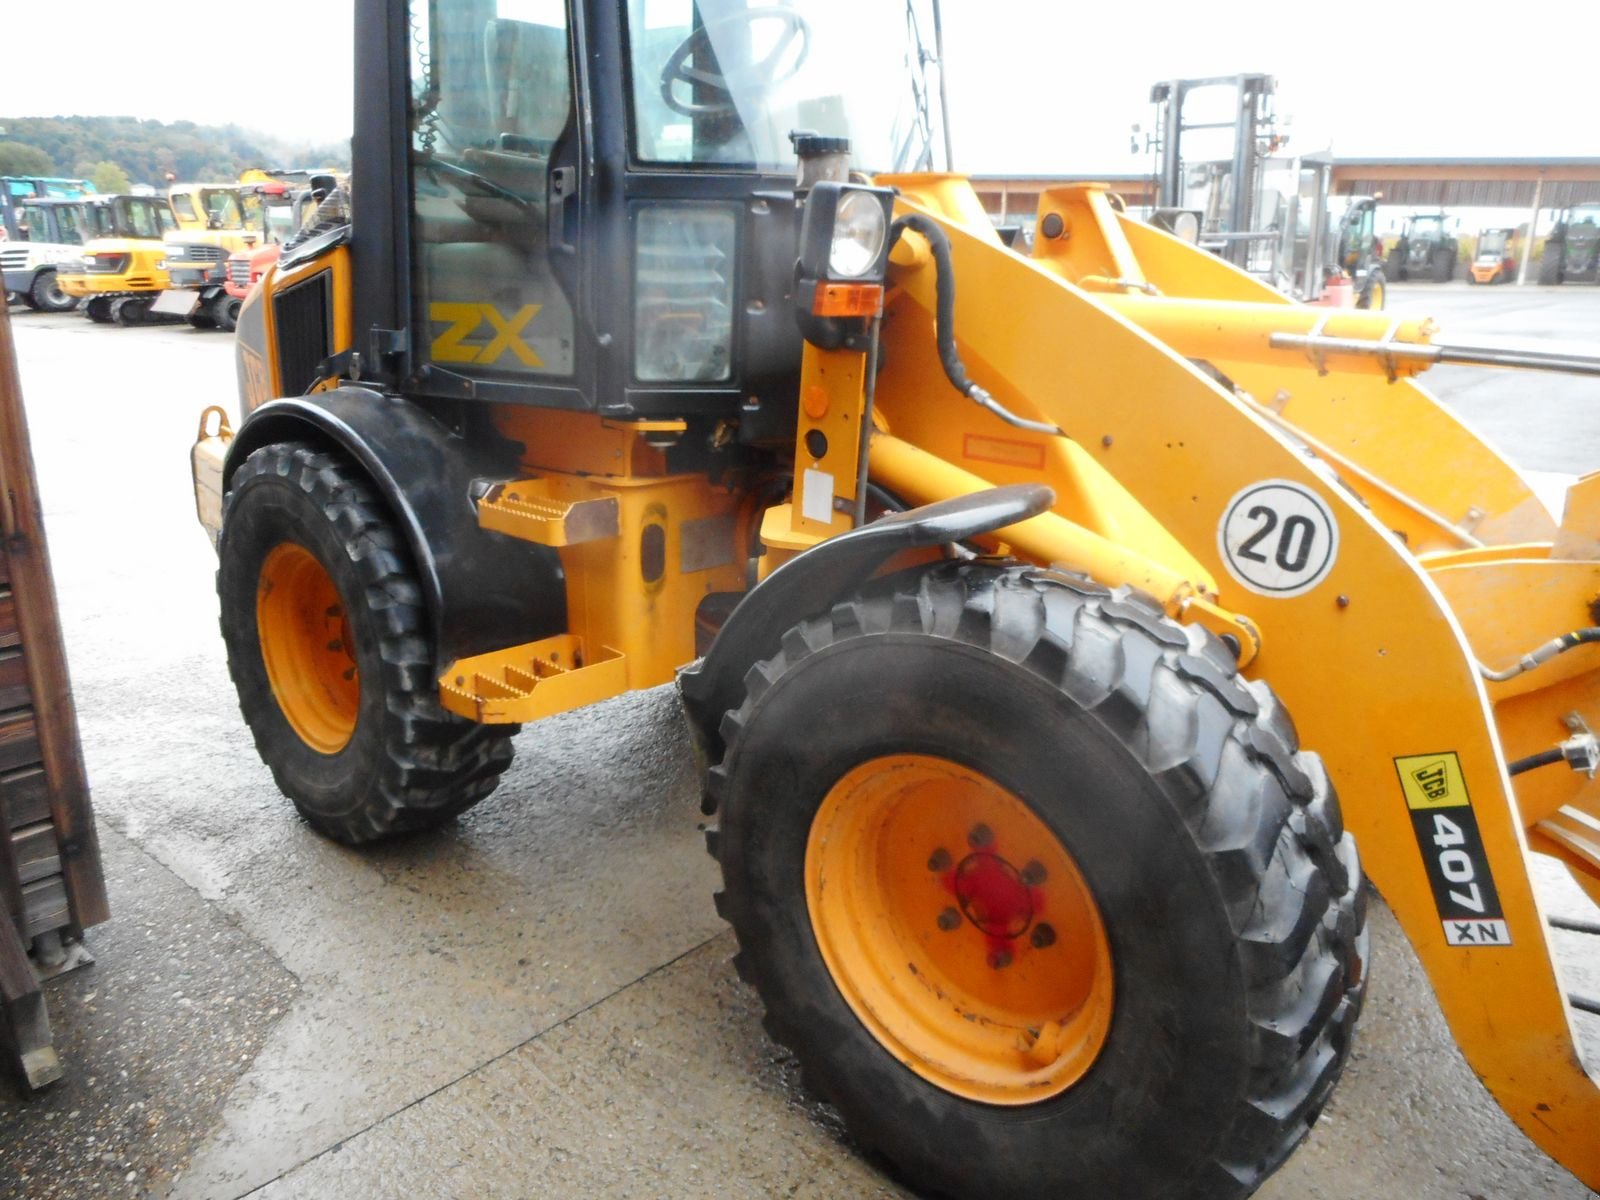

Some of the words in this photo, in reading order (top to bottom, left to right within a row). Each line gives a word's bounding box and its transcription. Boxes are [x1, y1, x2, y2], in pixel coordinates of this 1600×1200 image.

[429, 302, 545, 367] ZX
[1237, 505, 1316, 572] 20
[1416, 768, 1446, 799] JCB
[1433, 814, 1485, 912] 407
